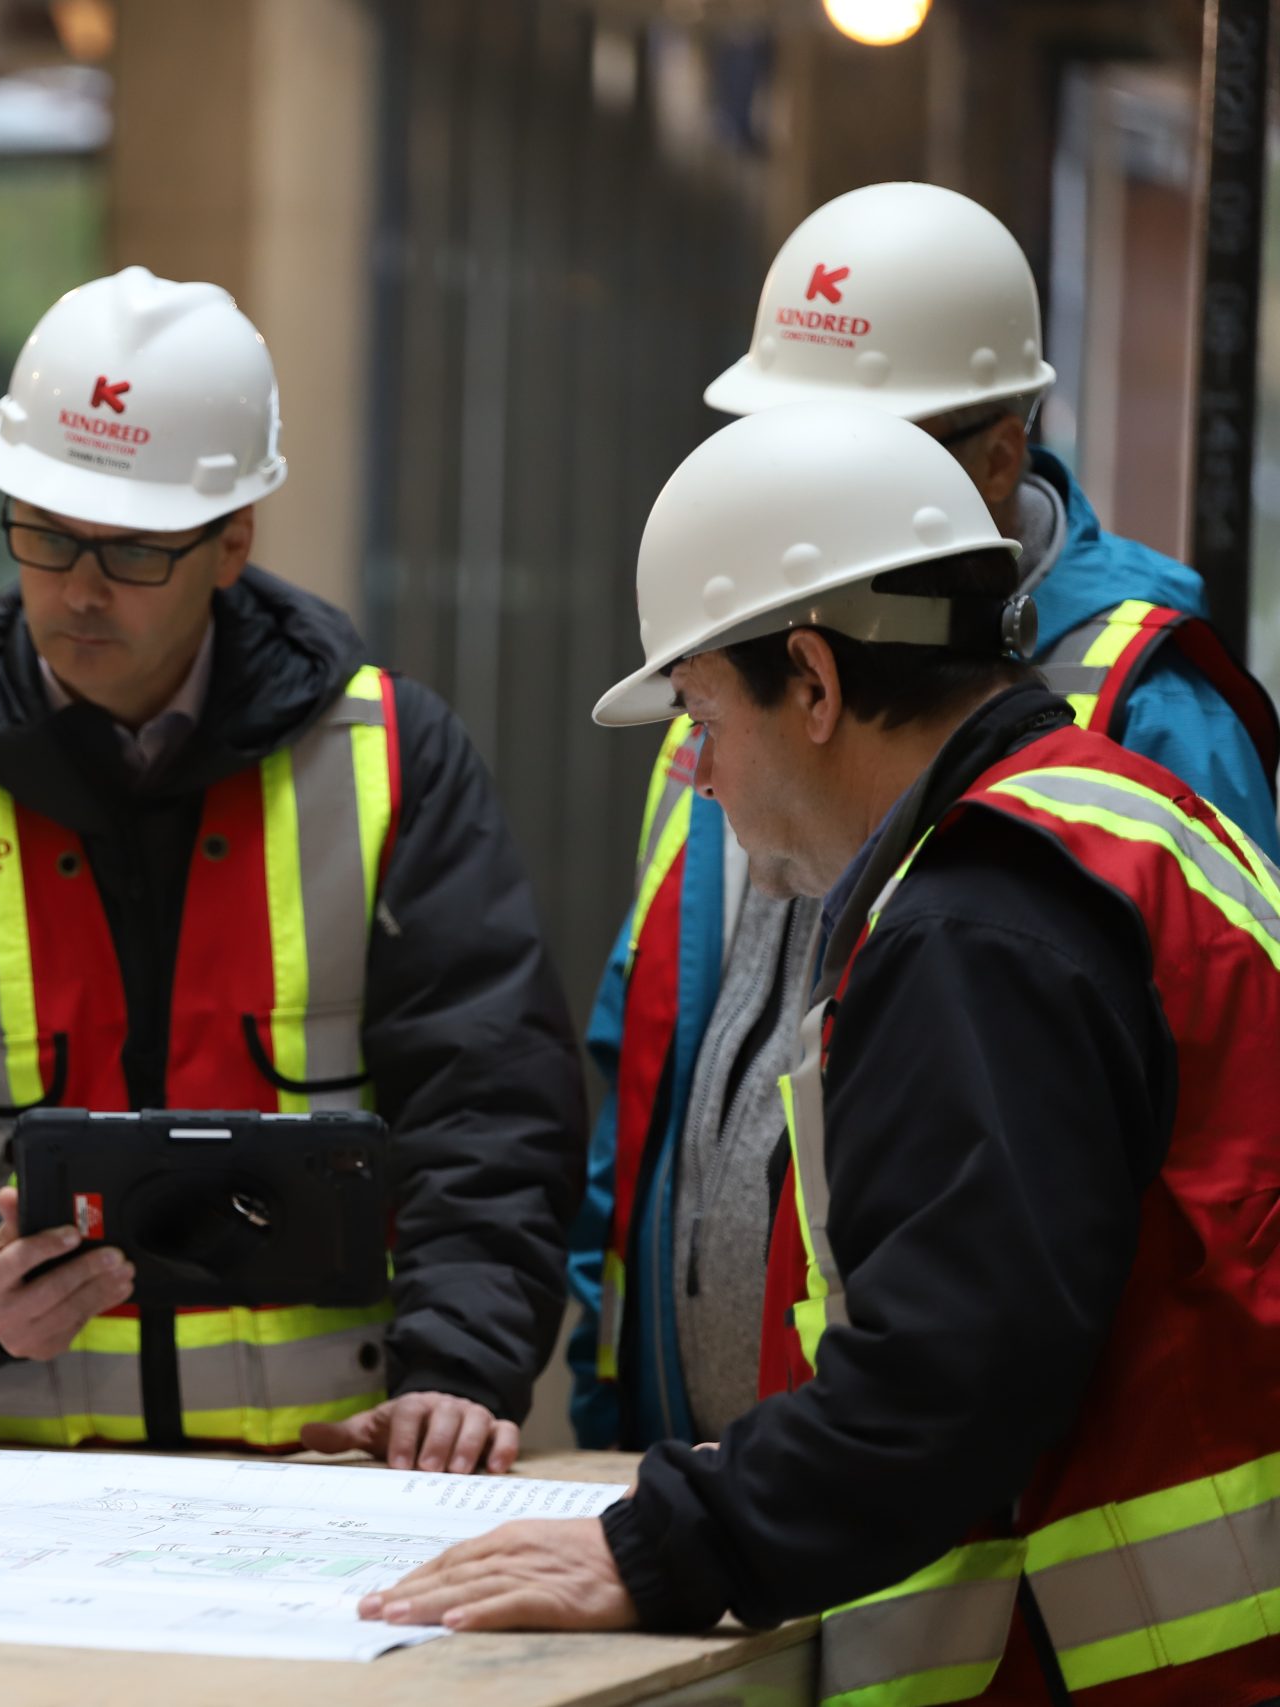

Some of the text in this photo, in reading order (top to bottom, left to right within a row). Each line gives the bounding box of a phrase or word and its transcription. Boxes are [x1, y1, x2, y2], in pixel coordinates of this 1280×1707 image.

[806, 264, 850, 304] K
[776, 307, 872, 336] KINDRED
[90, 376, 131, 414] K
[59, 408, 150, 445] KINDRED
